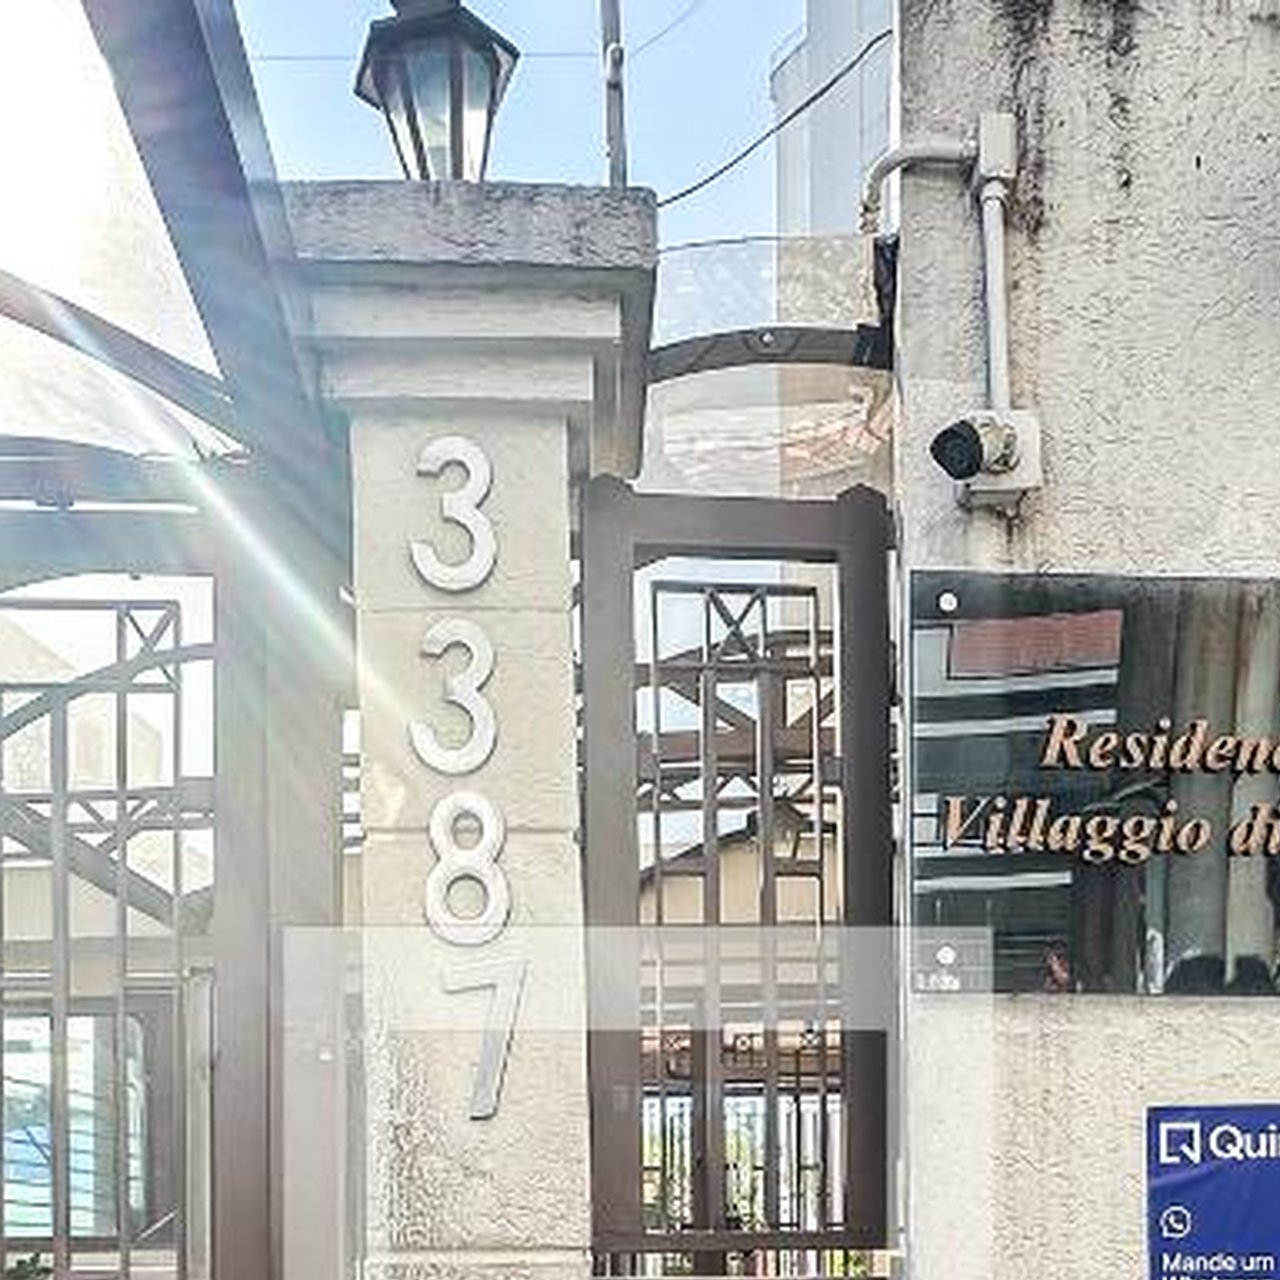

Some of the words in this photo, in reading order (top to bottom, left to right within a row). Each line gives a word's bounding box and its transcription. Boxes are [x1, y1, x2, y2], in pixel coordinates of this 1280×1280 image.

[409, 435, 530, 1121] 3387
[939, 795, 1211, 863] Villaggio
[1162, 1252, 1237, 1272] Mande
[1242, 1256, 1275, 1271] um
